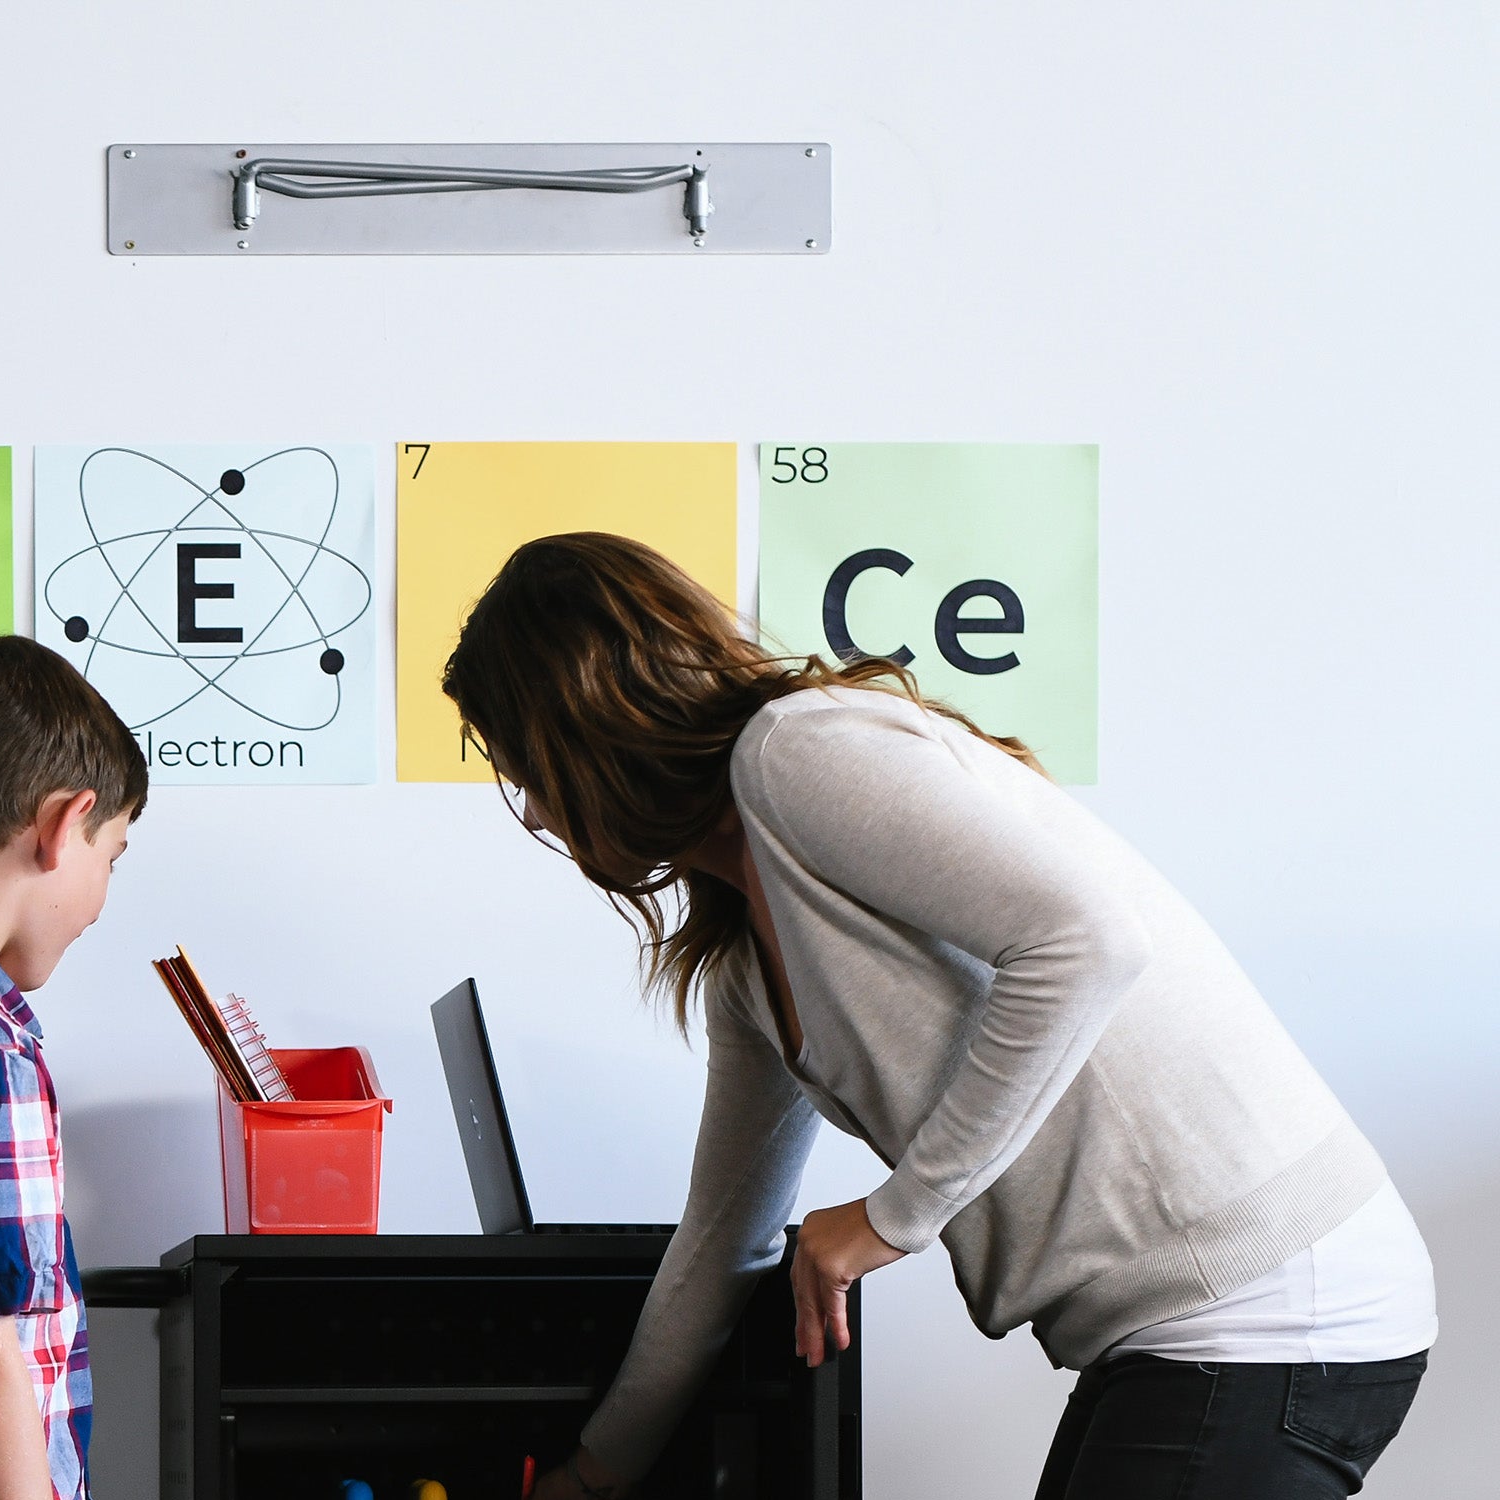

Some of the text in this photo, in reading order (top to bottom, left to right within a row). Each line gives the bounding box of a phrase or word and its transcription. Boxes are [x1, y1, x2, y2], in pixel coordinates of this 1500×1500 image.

[404, 444, 431, 480] 7
[771, 447, 829, 484] 58
[176, 543, 244, 643] E
[822, 548, 1025, 676] Ce
[131, 731, 304, 767] lectron
